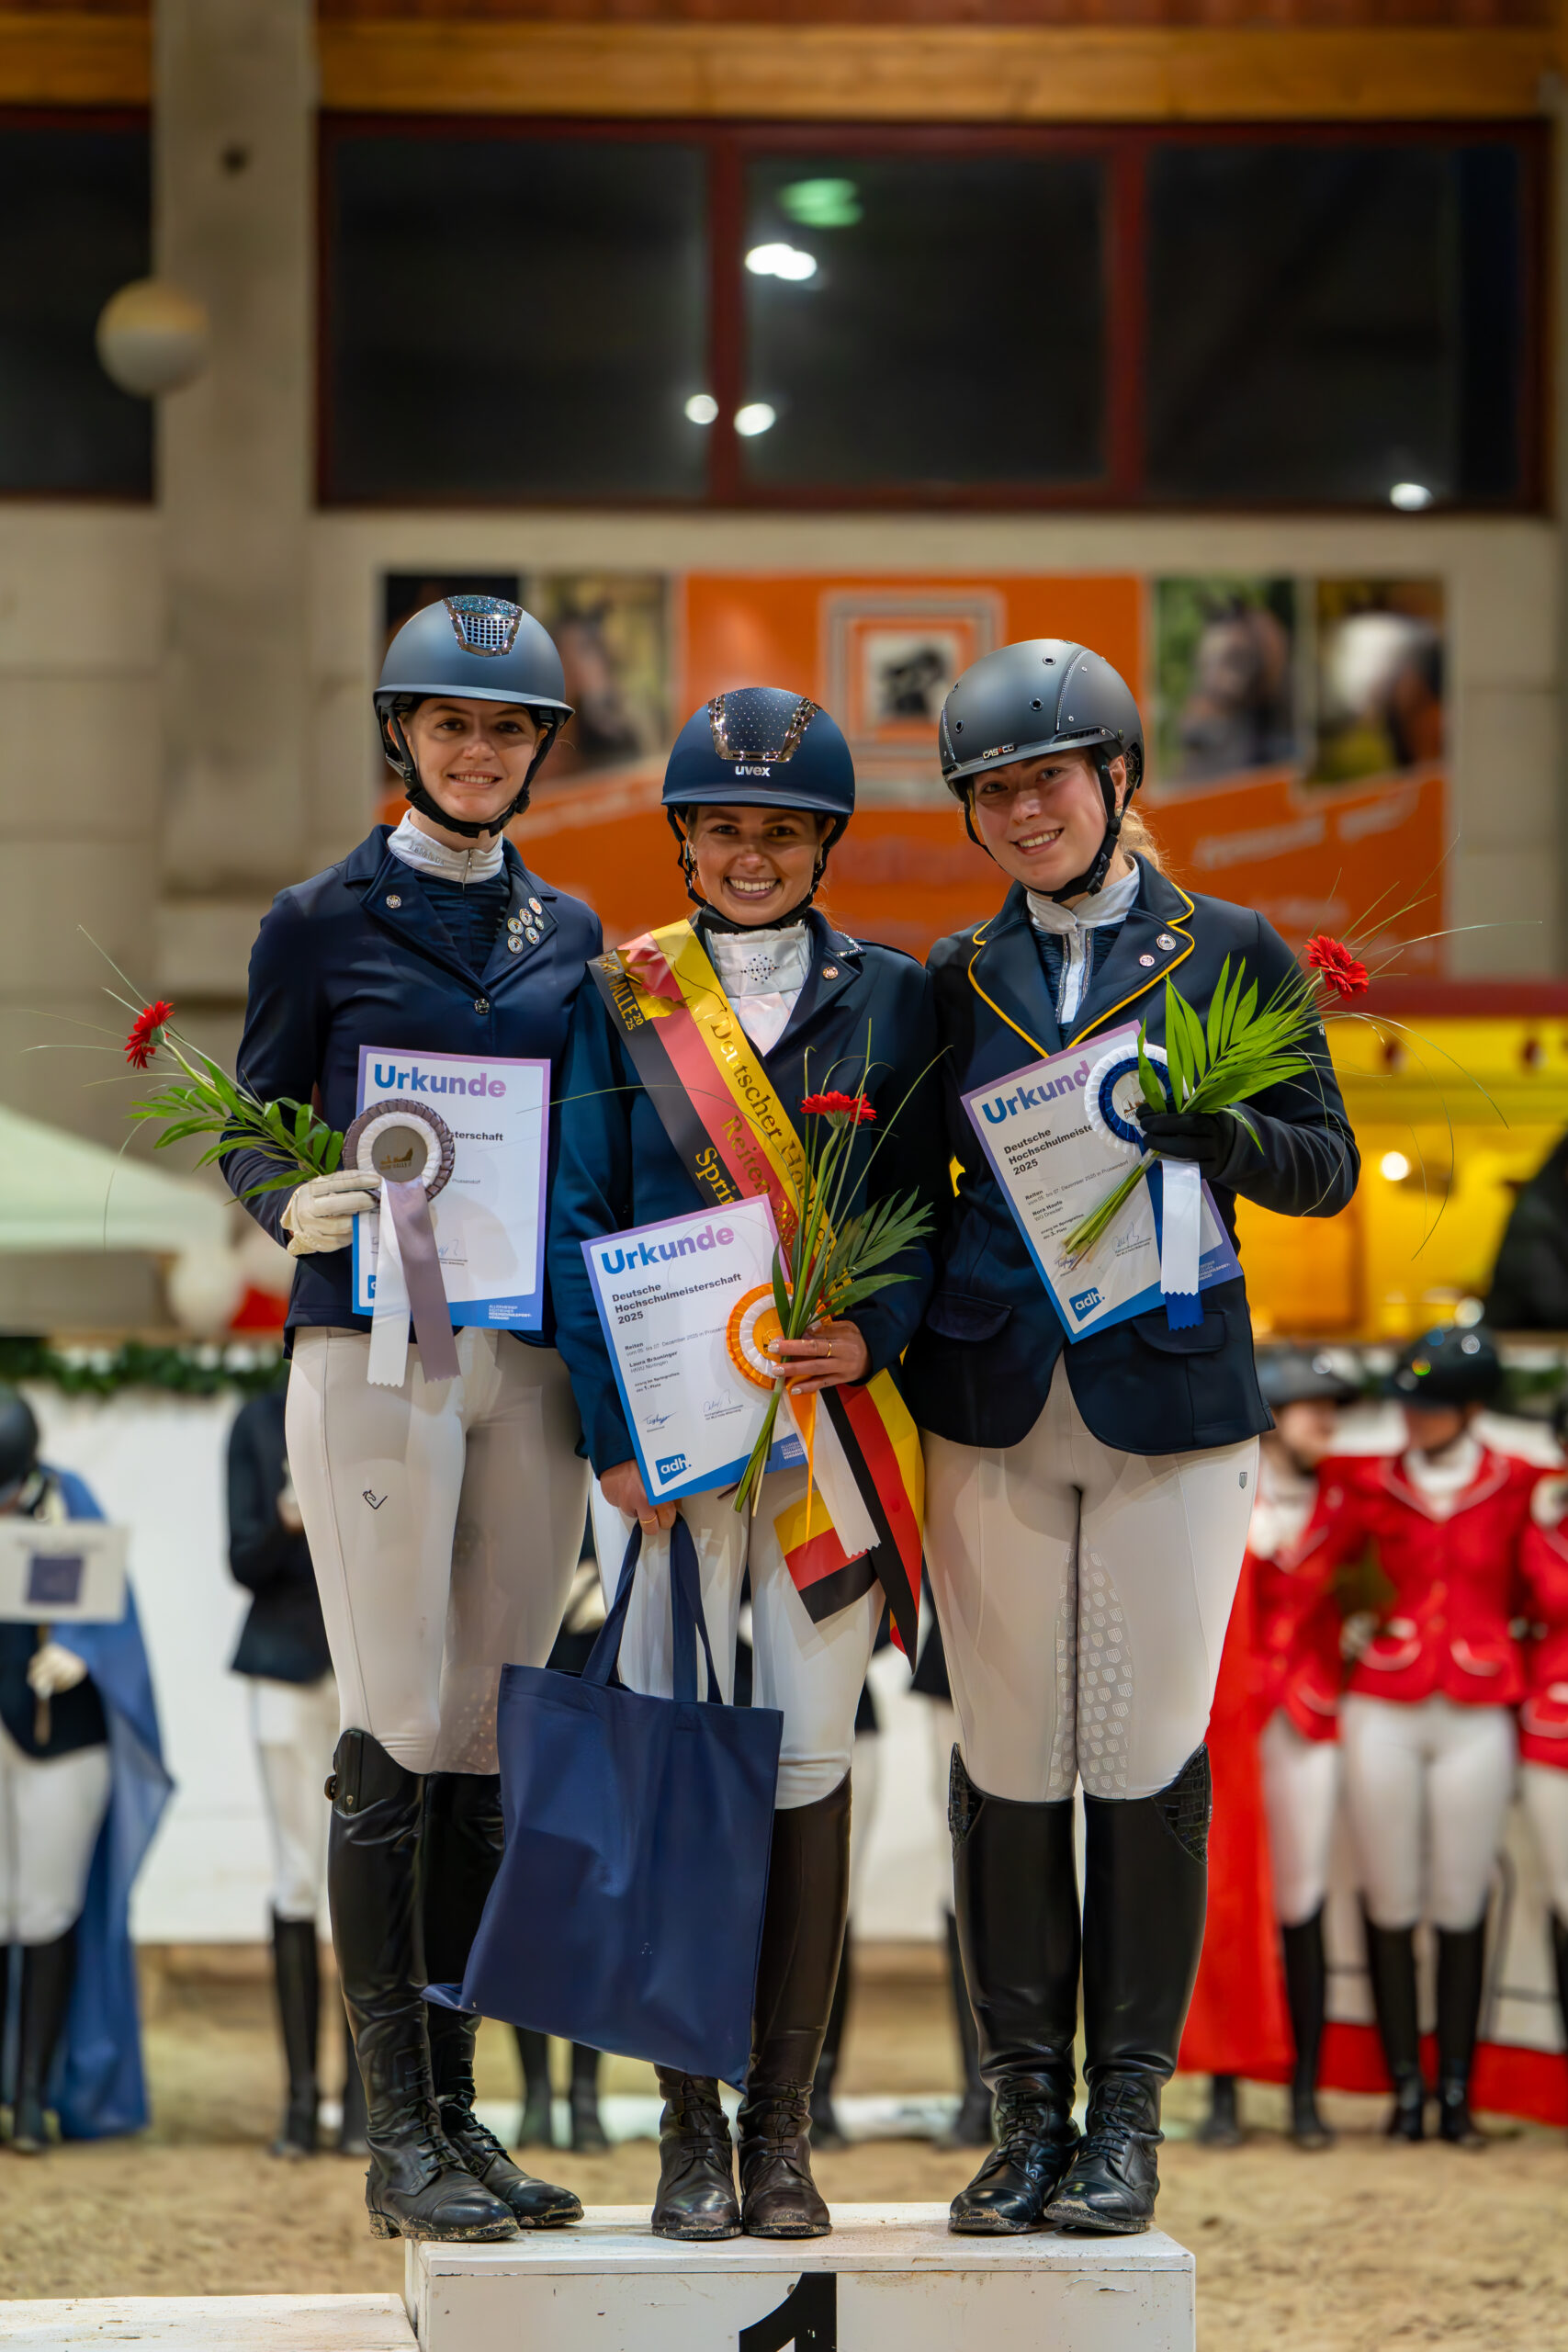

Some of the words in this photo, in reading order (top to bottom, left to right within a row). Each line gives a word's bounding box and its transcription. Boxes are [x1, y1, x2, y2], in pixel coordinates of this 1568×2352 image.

[735, 765, 771, 777] uvex
[606, 974, 638, 1020] HALLE
[375, 1064, 506, 1098] Urkunde
[710, 1016, 783, 1139] Deutscher
[982, 1060, 1092, 1124] Urkund
[720, 1114, 772, 1194] Reiten
[1004, 1129, 1052, 1155] Deutsche
[1008, 1125, 1093, 1165] Hochschulmeiste
[1012, 1159, 1039, 1176] 2025
[1025, 1190, 1043, 1200] Reiten
[601, 1225, 735, 1275] Urkunde
[612, 1283, 661, 1303] Deutsche
[615, 1272, 742, 1314] Hochschulmeisterschaft
[617, 1311, 644, 1324] 2025
[625, 1341, 644, 1351] Reiten
[629, 1359, 646, 1367] Laura
[739, 2272, 837, 2352] 1
